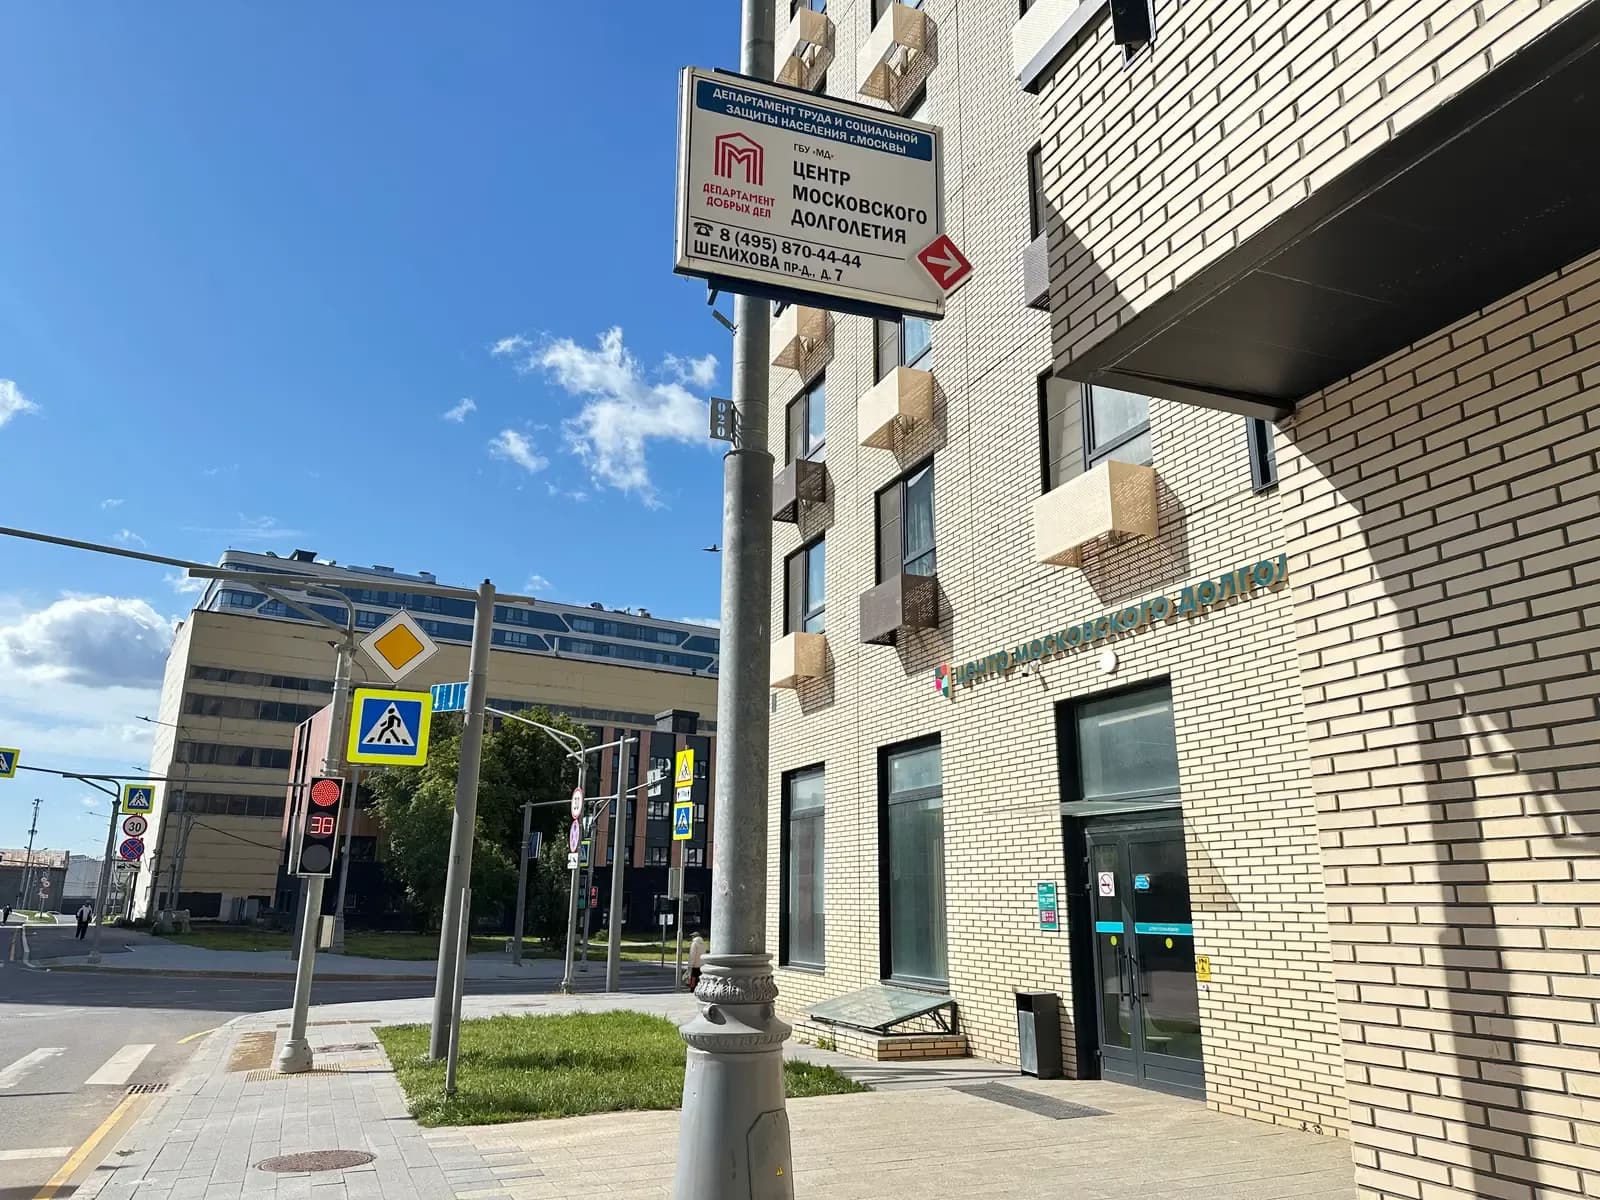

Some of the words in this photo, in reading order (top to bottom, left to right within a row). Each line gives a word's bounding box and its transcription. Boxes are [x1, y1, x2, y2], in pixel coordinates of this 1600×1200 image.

[713, 88, 795, 115] ДЕПАРТАМЕНТ
[798, 108, 831, 124] ТРУДА
[835, 117, 842, 125] И
[846, 119, 918, 144] СОЦИАЛЬНОЙ
[726, 105, 778, 125] ЗАЩИТЫ
[781, 118, 846, 141] НАСЕЛЕНИЯ
[850, 137, 906, 155] г.МОСКВЫ
[794, 144, 810, 154] ГБУ
[793, 161, 850, 185] ЦЕНТР
[703, 183, 775, 208] ДЕПАРТАМЕНТ
[707, 197, 750, 214] ДОБРЫХ
[753, 206, 771, 219] ДЕЛ
[793, 185, 927, 224] МОСКОВСКОГО
[791, 209, 906, 244] ДОЛГОЛЕТИЯ
[694, 240, 779, 269] ШЕЛИХОВА
[835, 269, 843, 281] 7
[720, 229, 730, 241] 8
[735, 230, 777, 252] (495)
[782, 243, 861, 268] 870-44-44
[128, 821, 142, 832] 30
[310, 816, 334, 835] 38
